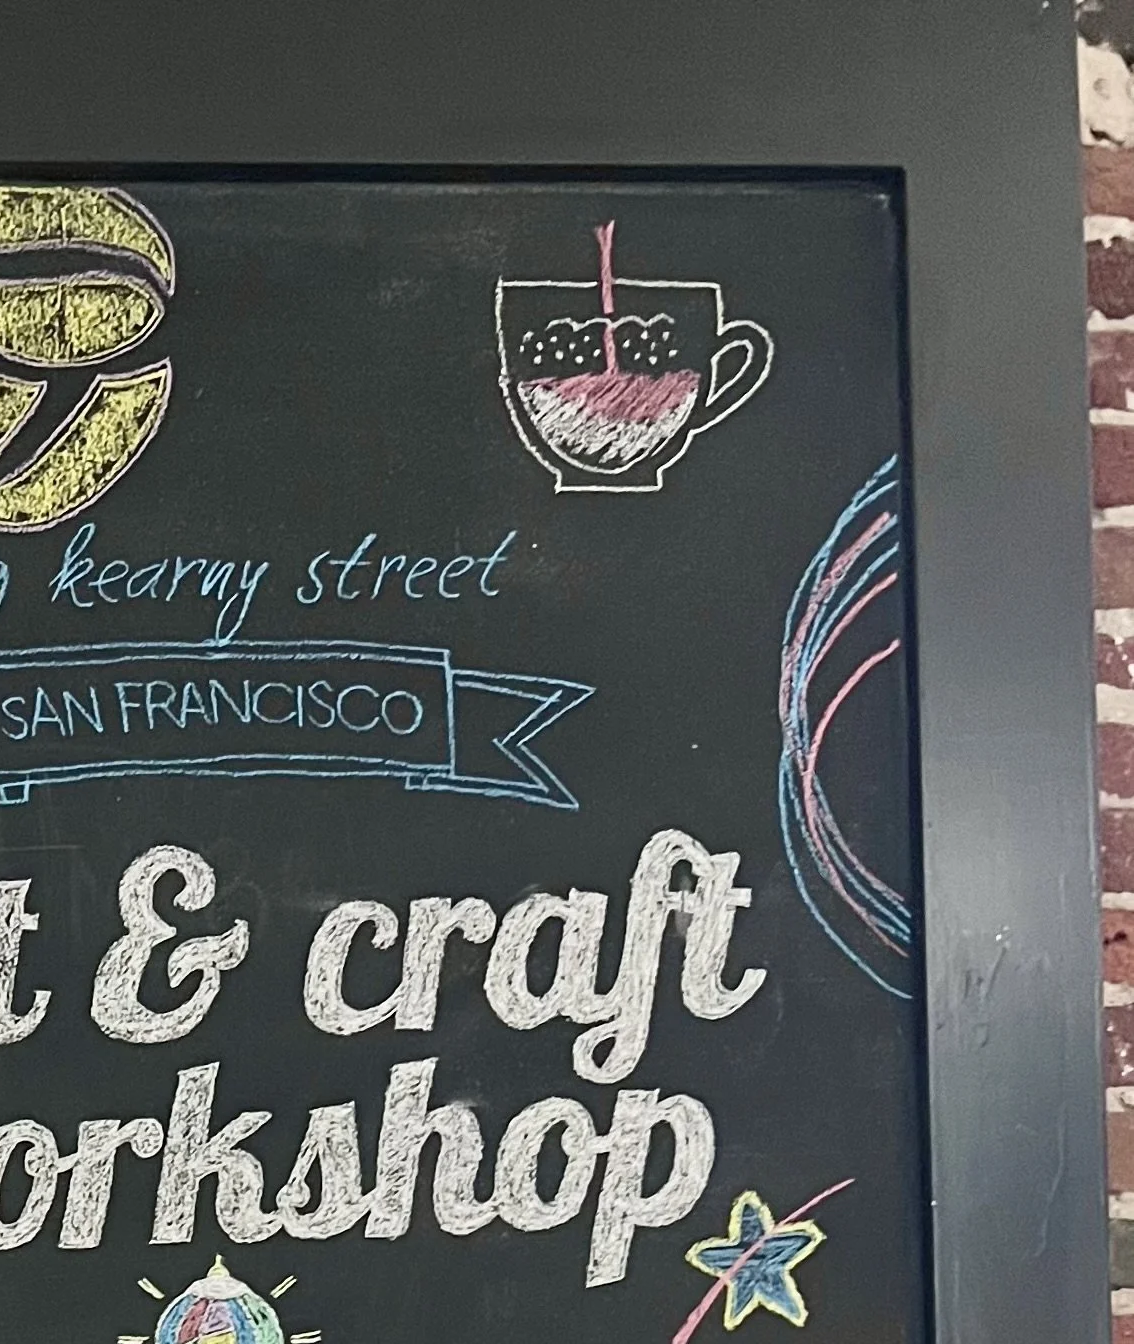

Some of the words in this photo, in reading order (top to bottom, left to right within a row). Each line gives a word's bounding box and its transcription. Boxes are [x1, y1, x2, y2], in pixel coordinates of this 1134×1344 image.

[49, 522, 269, 646] kearny
[296, 530, 519, 604] street
[0, 684, 104, 740] SAN
[120, 678, 425, 735] FRANCISCO
[90, 844, 251, 1044] &
[302, 828, 769, 1084] craft
